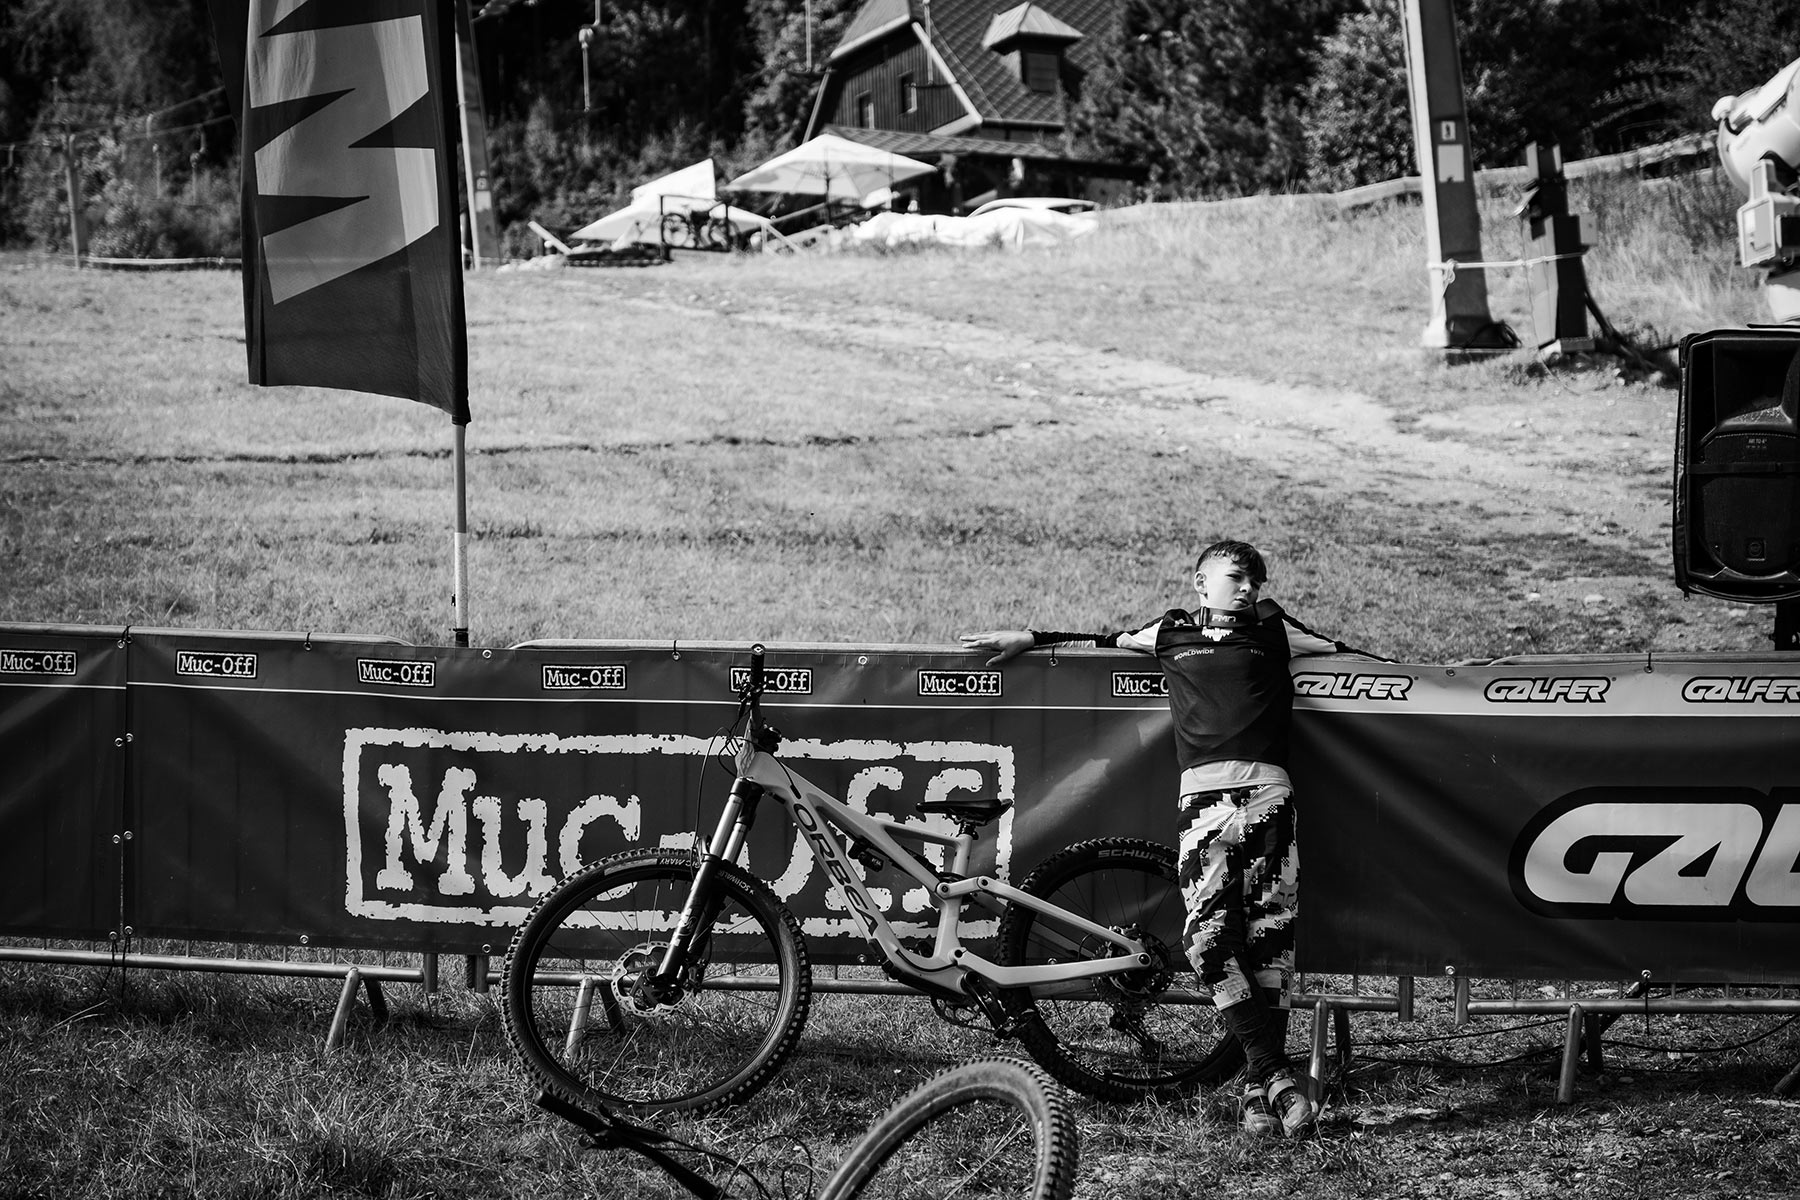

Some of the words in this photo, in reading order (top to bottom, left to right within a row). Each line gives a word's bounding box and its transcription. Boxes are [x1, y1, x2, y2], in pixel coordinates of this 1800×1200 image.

[248, 0, 440, 305] M
[2, 654, 73, 672] Muc-Off
[1174, 648, 1215, 660] WORLDWIDE
[180, 655, 254, 675] Muc-Off
[361, 663, 432, 684] Muc-Off
[546, 665, 622, 687] Muc-Off
[734, 672, 808, 690] M-Off
[923, 674, 998, 693] Muc-Off
[1293, 673, 1413, 699] GALFER
[1485, 678, 1609, 702] GALFER
[794, 803, 879, 936] ORBEA
